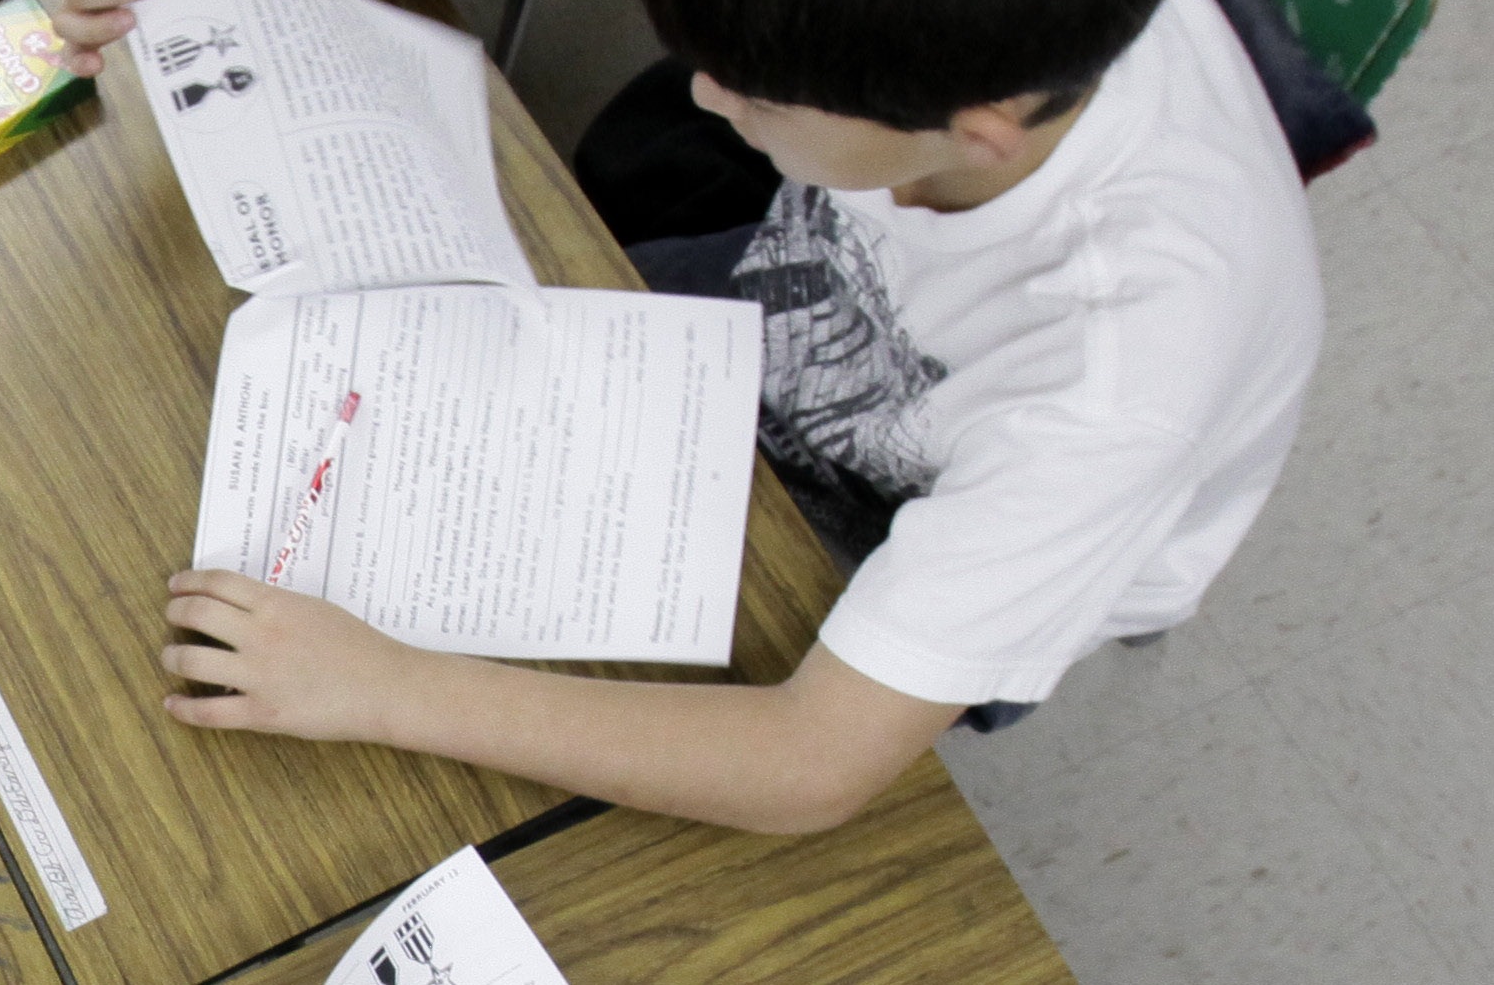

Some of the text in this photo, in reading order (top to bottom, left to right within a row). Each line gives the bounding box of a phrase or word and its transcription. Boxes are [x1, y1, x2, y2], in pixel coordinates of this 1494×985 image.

[229, 191, 251, 216] OF
[228, 372, 252, 490] SUSAN B. ANTHONY
[257, 412, 266, 430] the
[253, 433, 263, 458] from
[279, 486, 292, 533] important
[293, 359, 308, 419] Constitution
[368, 421, 380, 459] growing
[250, 461, 260, 492] words
[365, 462, 373, 480] was
[245, 495, 255, 518] with
[358, 483, 371, 523] Anthony
[240, 522, 252, 557] blanks
[355, 528, 365, 538] B.
[353, 540, 364, 568] Susan
[347, 570, 359, 599] When
[413, 572, 422, 588] the
[400, 866, 459, 914] FEBRUARY 13
